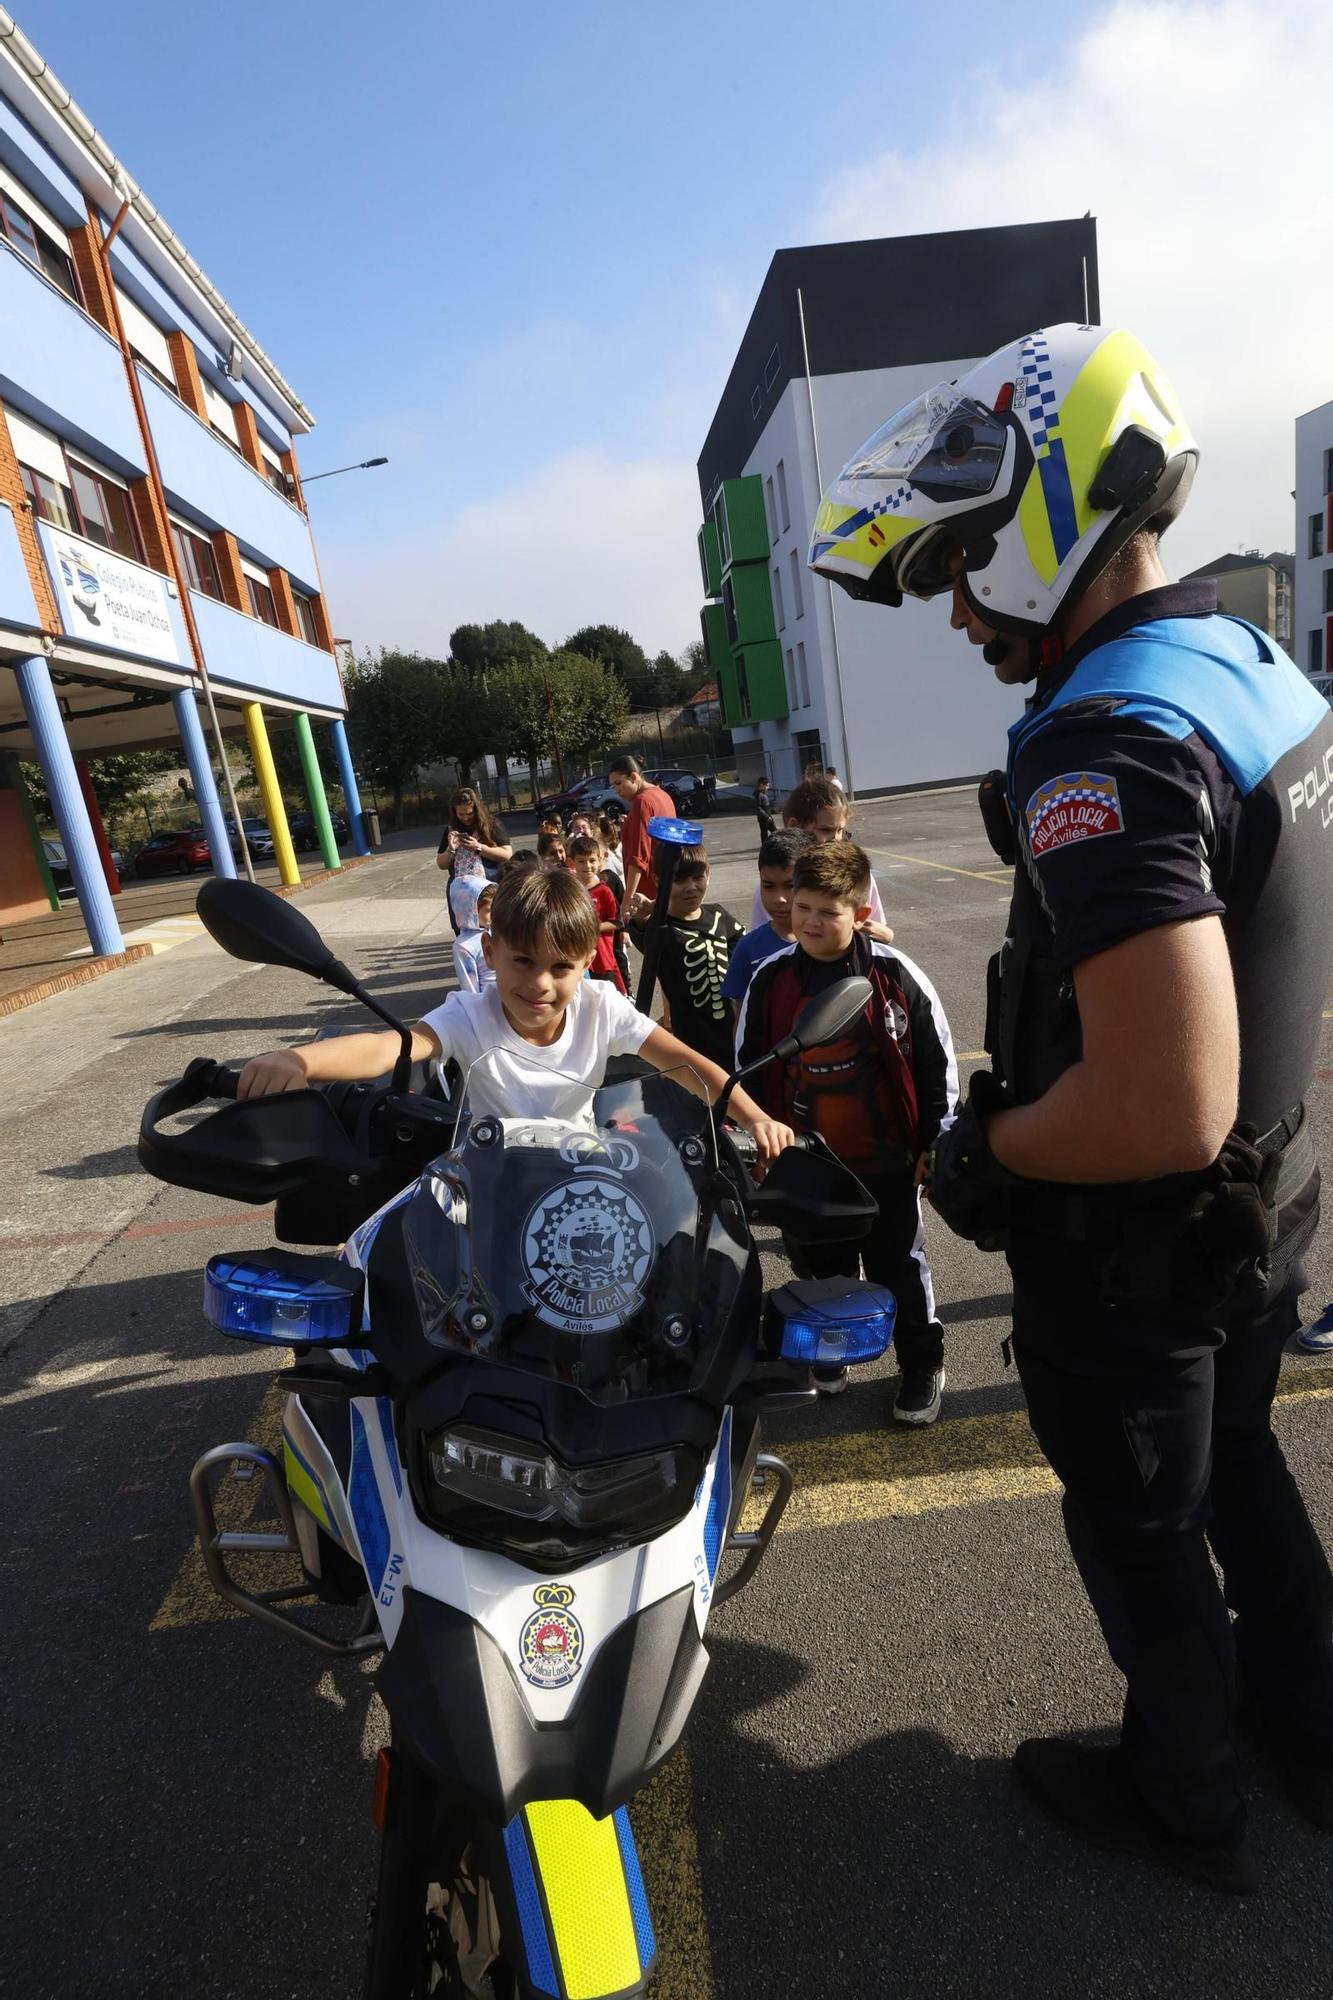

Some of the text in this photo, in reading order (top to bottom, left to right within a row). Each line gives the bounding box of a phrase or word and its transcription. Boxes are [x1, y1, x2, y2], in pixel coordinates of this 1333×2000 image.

[104, 593, 129, 619] Poeta
[129, 604, 148, 625] Juan
[1034, 806, 1108, 849] POLICÍA LOCAL
[1051, 825, 1088, 846] Avilés
[541, 1279, 626, 1315] Policía Local
[562, 1320, 593, 1331] Avilés
[381, 1554, 404, 1606] M-13
[694, 1555, 709, 1603] M-13
[552, 1664, 570, 1676] Local
